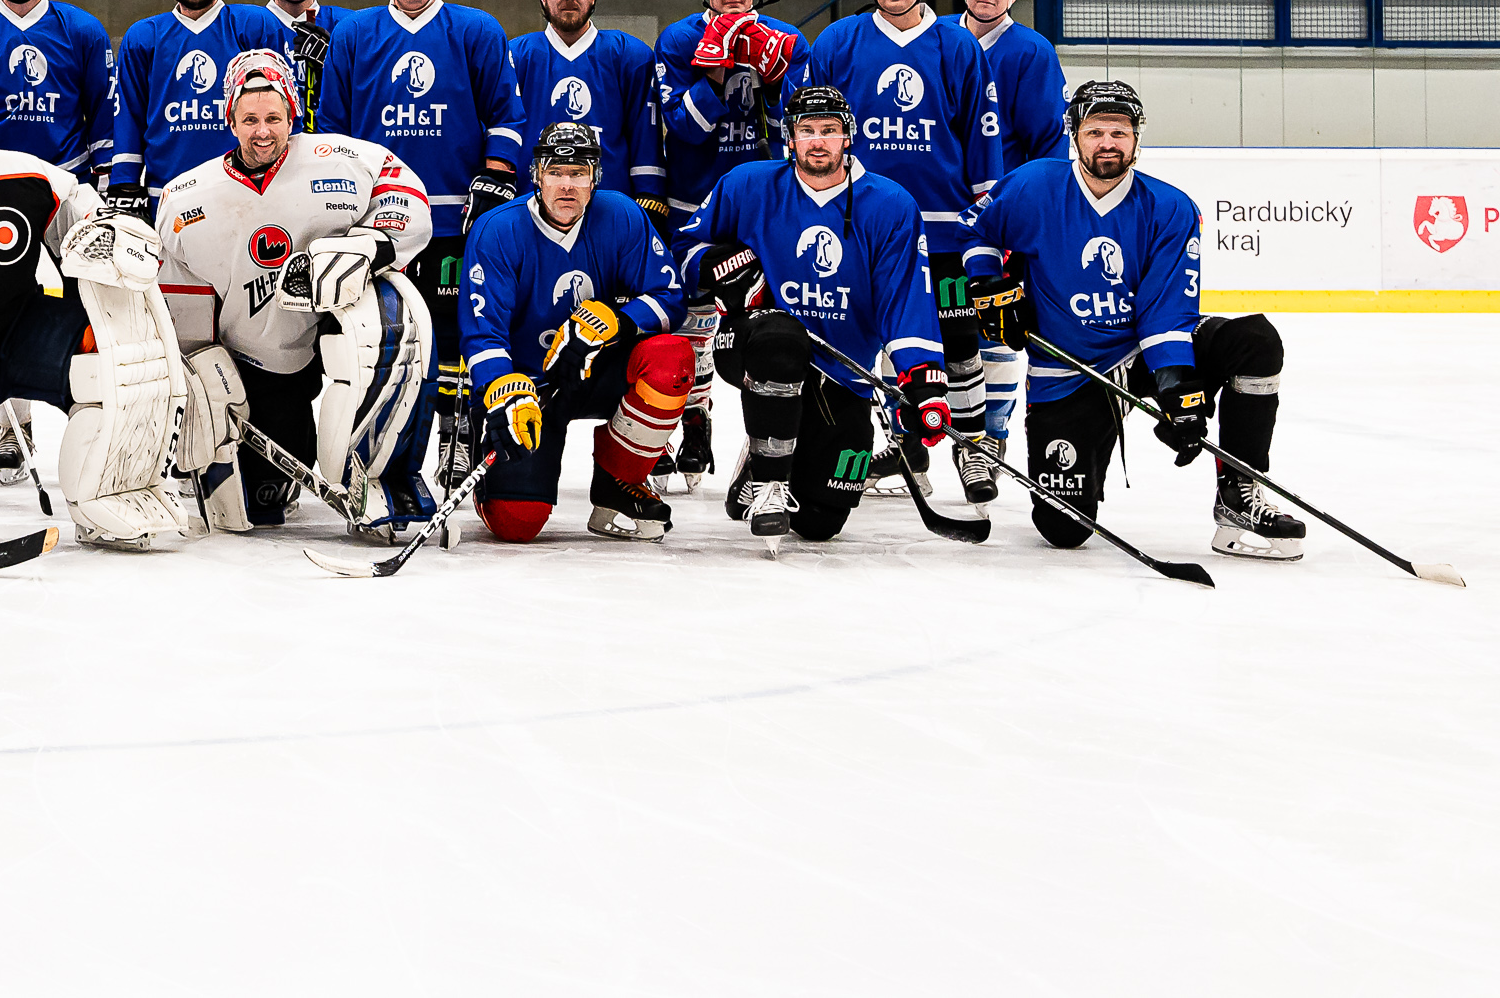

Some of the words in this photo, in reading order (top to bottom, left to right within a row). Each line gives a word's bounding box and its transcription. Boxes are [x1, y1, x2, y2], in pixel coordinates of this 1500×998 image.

[6, 92, 61, 113] CH&T
[164, 98, 227, 123] CH&T
[381, 103, 448, 127] CH&T
[981, 112, 1000, 138] 8
[169, 123, 226, 133] PARDUBICE
[385, 128, 443, 138] PARDUBICE
[718, 122, 756, 142] CH&
[863, 117, 937, 142] CH&T
[869, 142, 933, 152] PARDUBICE
[312, 179, 357, 194] deník
[106, 196, 149, 208] CCM
[325, 201, 359, 213] Reebok
[180, 206, 205, 223] TASK
[1216, 200, 1353, 227] Pardubický
[1217, 230, 1261, 256] kraj
[661, 265, 682, 290] 2
[1184, 269, 1199, 298] 3
[780, 281, 850, 308] CH&T
[827, 479, 867, 492] MARHOL
[1039, 472, 1086, 489] CH&T
[422, 465, 487, 537] EASTON
